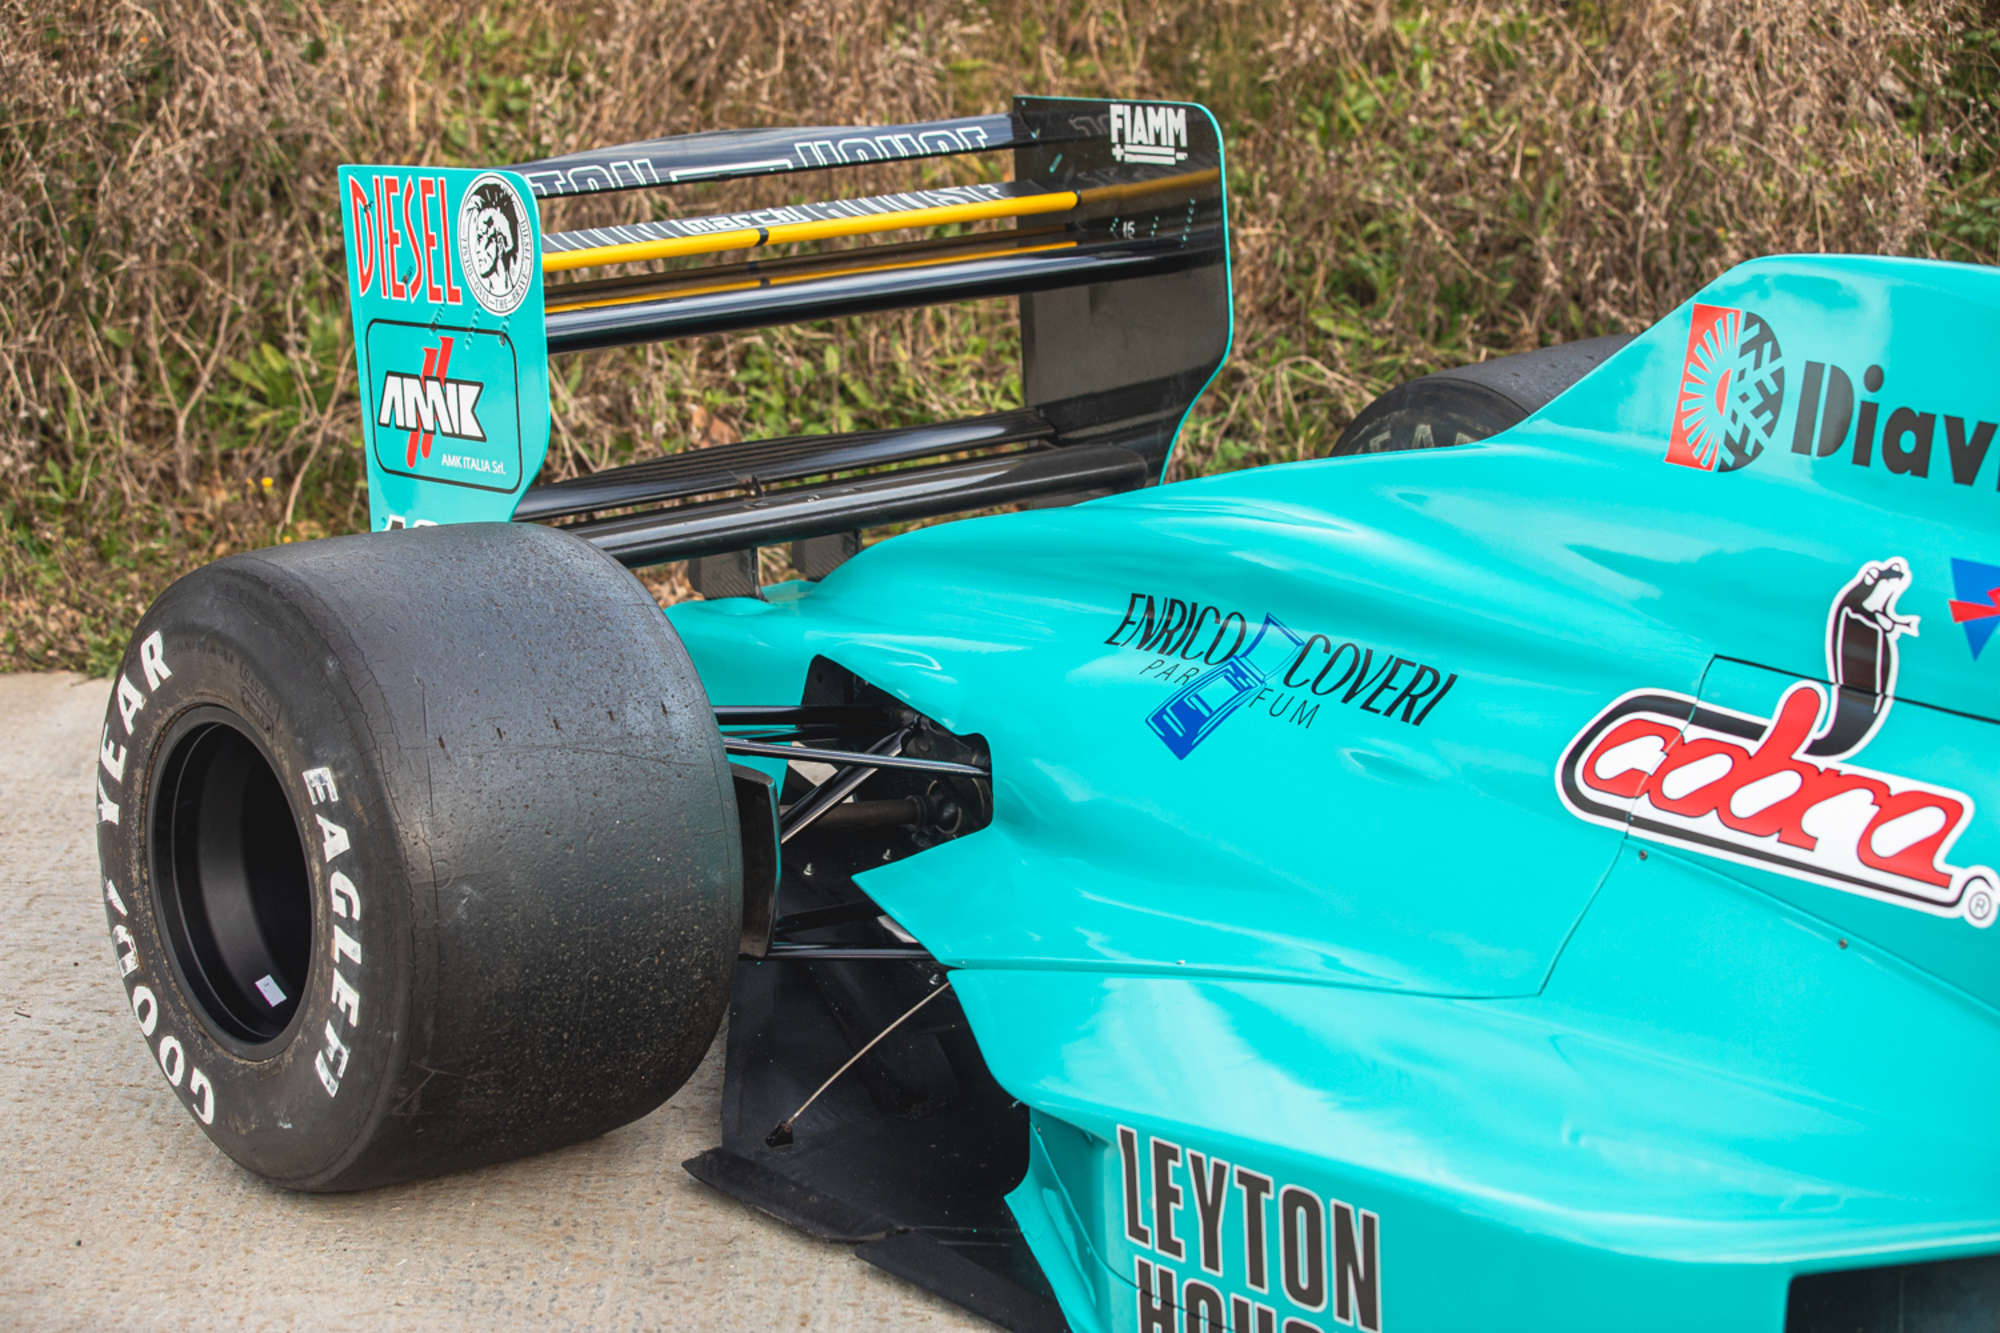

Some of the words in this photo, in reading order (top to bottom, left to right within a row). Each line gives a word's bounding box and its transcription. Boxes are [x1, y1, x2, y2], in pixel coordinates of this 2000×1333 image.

[1109, 103, 1188, 148] FIAMM
[348, 174, 463, 305] DIESEL
[378, 371, 487, 442] AMK
[1791, 360, 2000, 493] Diav
[441, 453, 462, 468] AMK
[463, 456, 491, 472] ITALIA
[1104, 592, 1247, 666] ENRICO
[1283, 633, 1459, 727] COVERI
[1583, 686, 1953, 889] cobra
[1116, 1123, 1382, 1333] LEYTON
